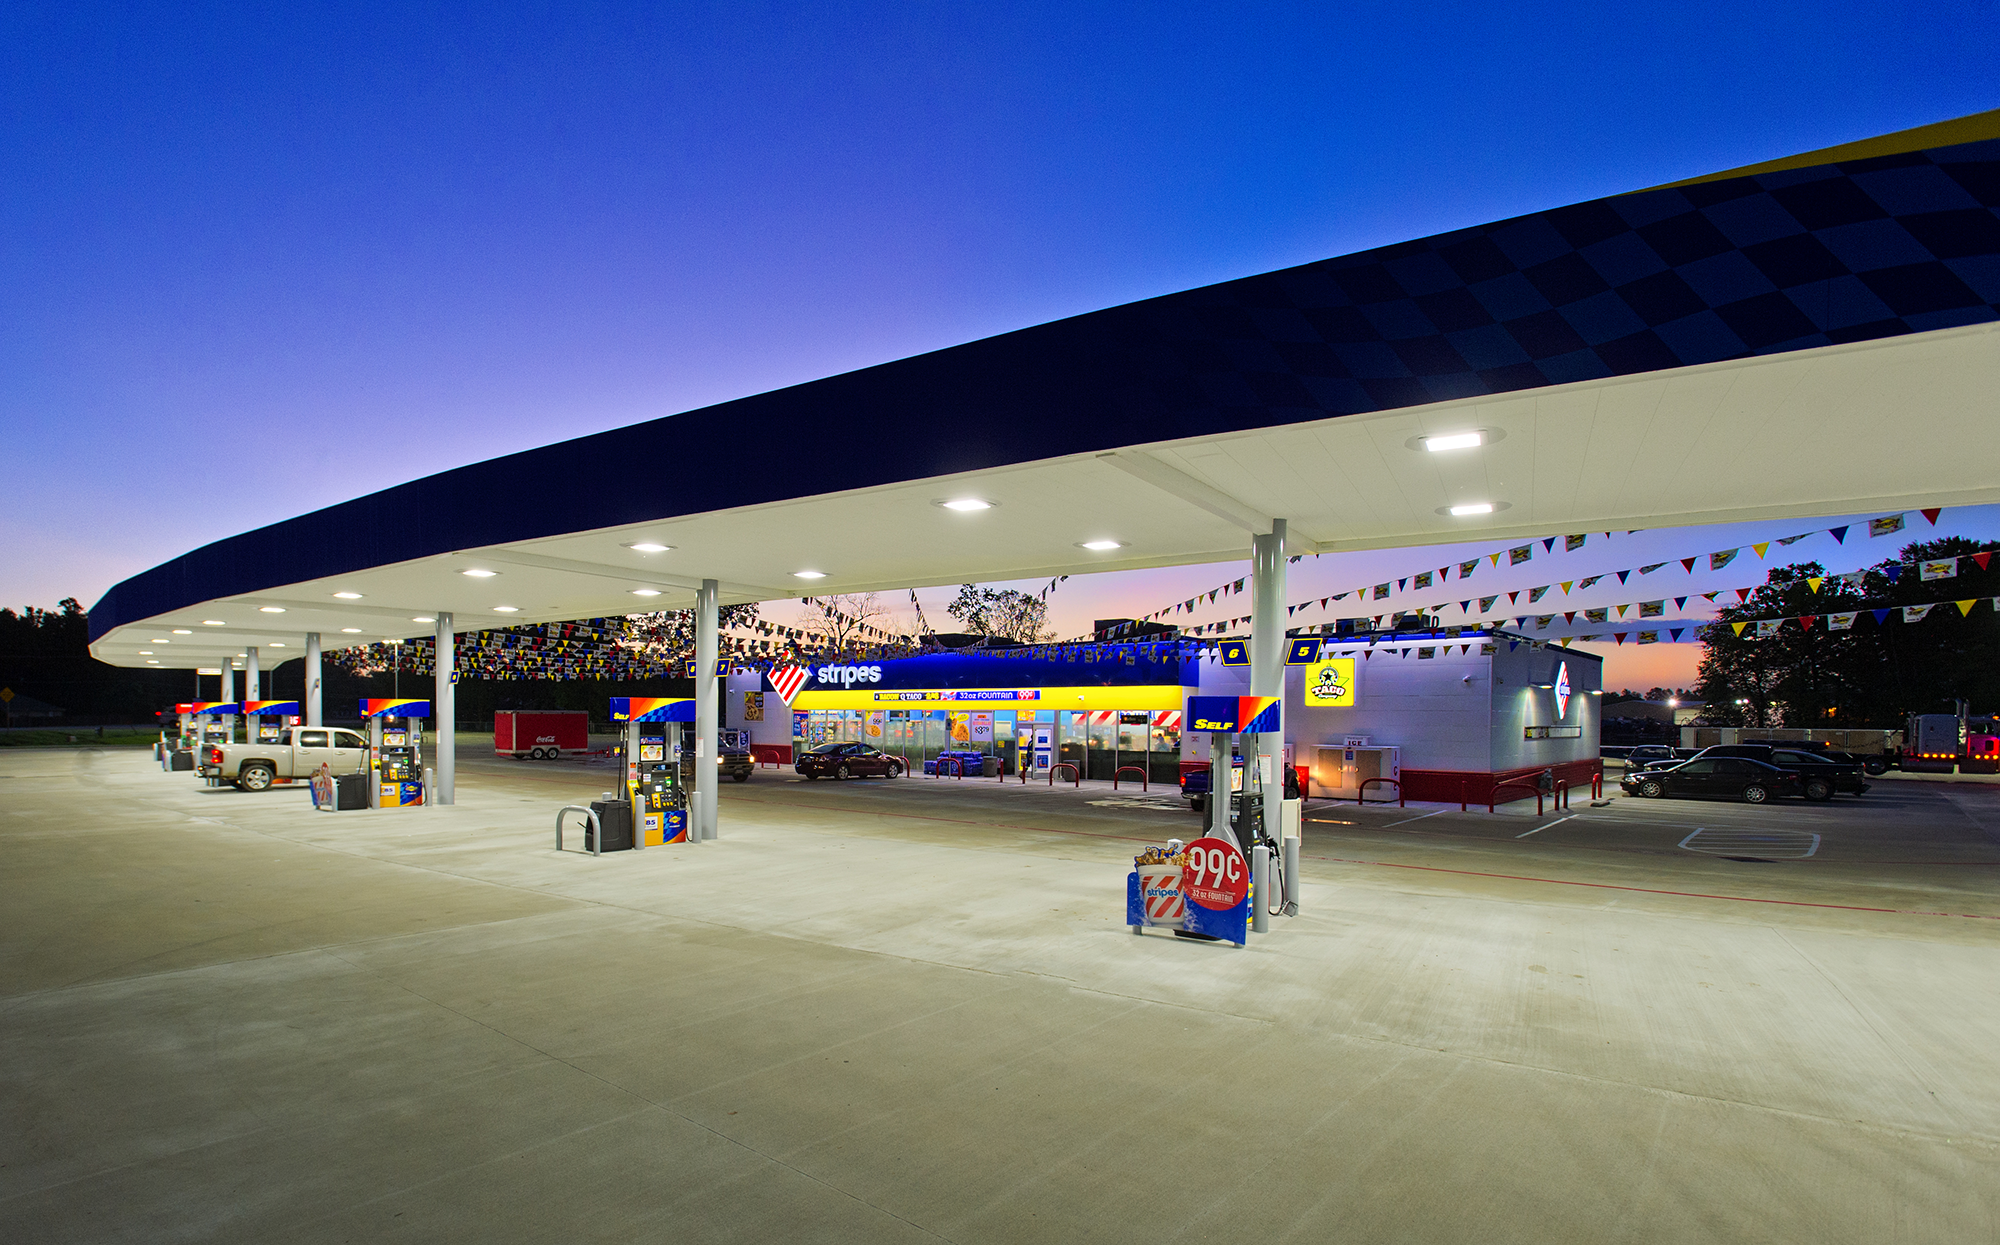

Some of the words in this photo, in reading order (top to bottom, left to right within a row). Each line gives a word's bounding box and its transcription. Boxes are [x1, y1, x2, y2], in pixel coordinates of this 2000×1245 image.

[1228, 648, 1240, 659] 6
[1298, 646, 1310, 657] 5
[818, 663, 882, 689] stripes
[978, 691, 1014, 699] FOUNTAIN
[1311, 685, 1346, 697] TACO
[1194, 719, 1233, 729] SELF
[1189, 846, 1241, 889] 99¢
[1147, 886, 1179, 898] stripes
[1192, 888, 1201, 898] 32
